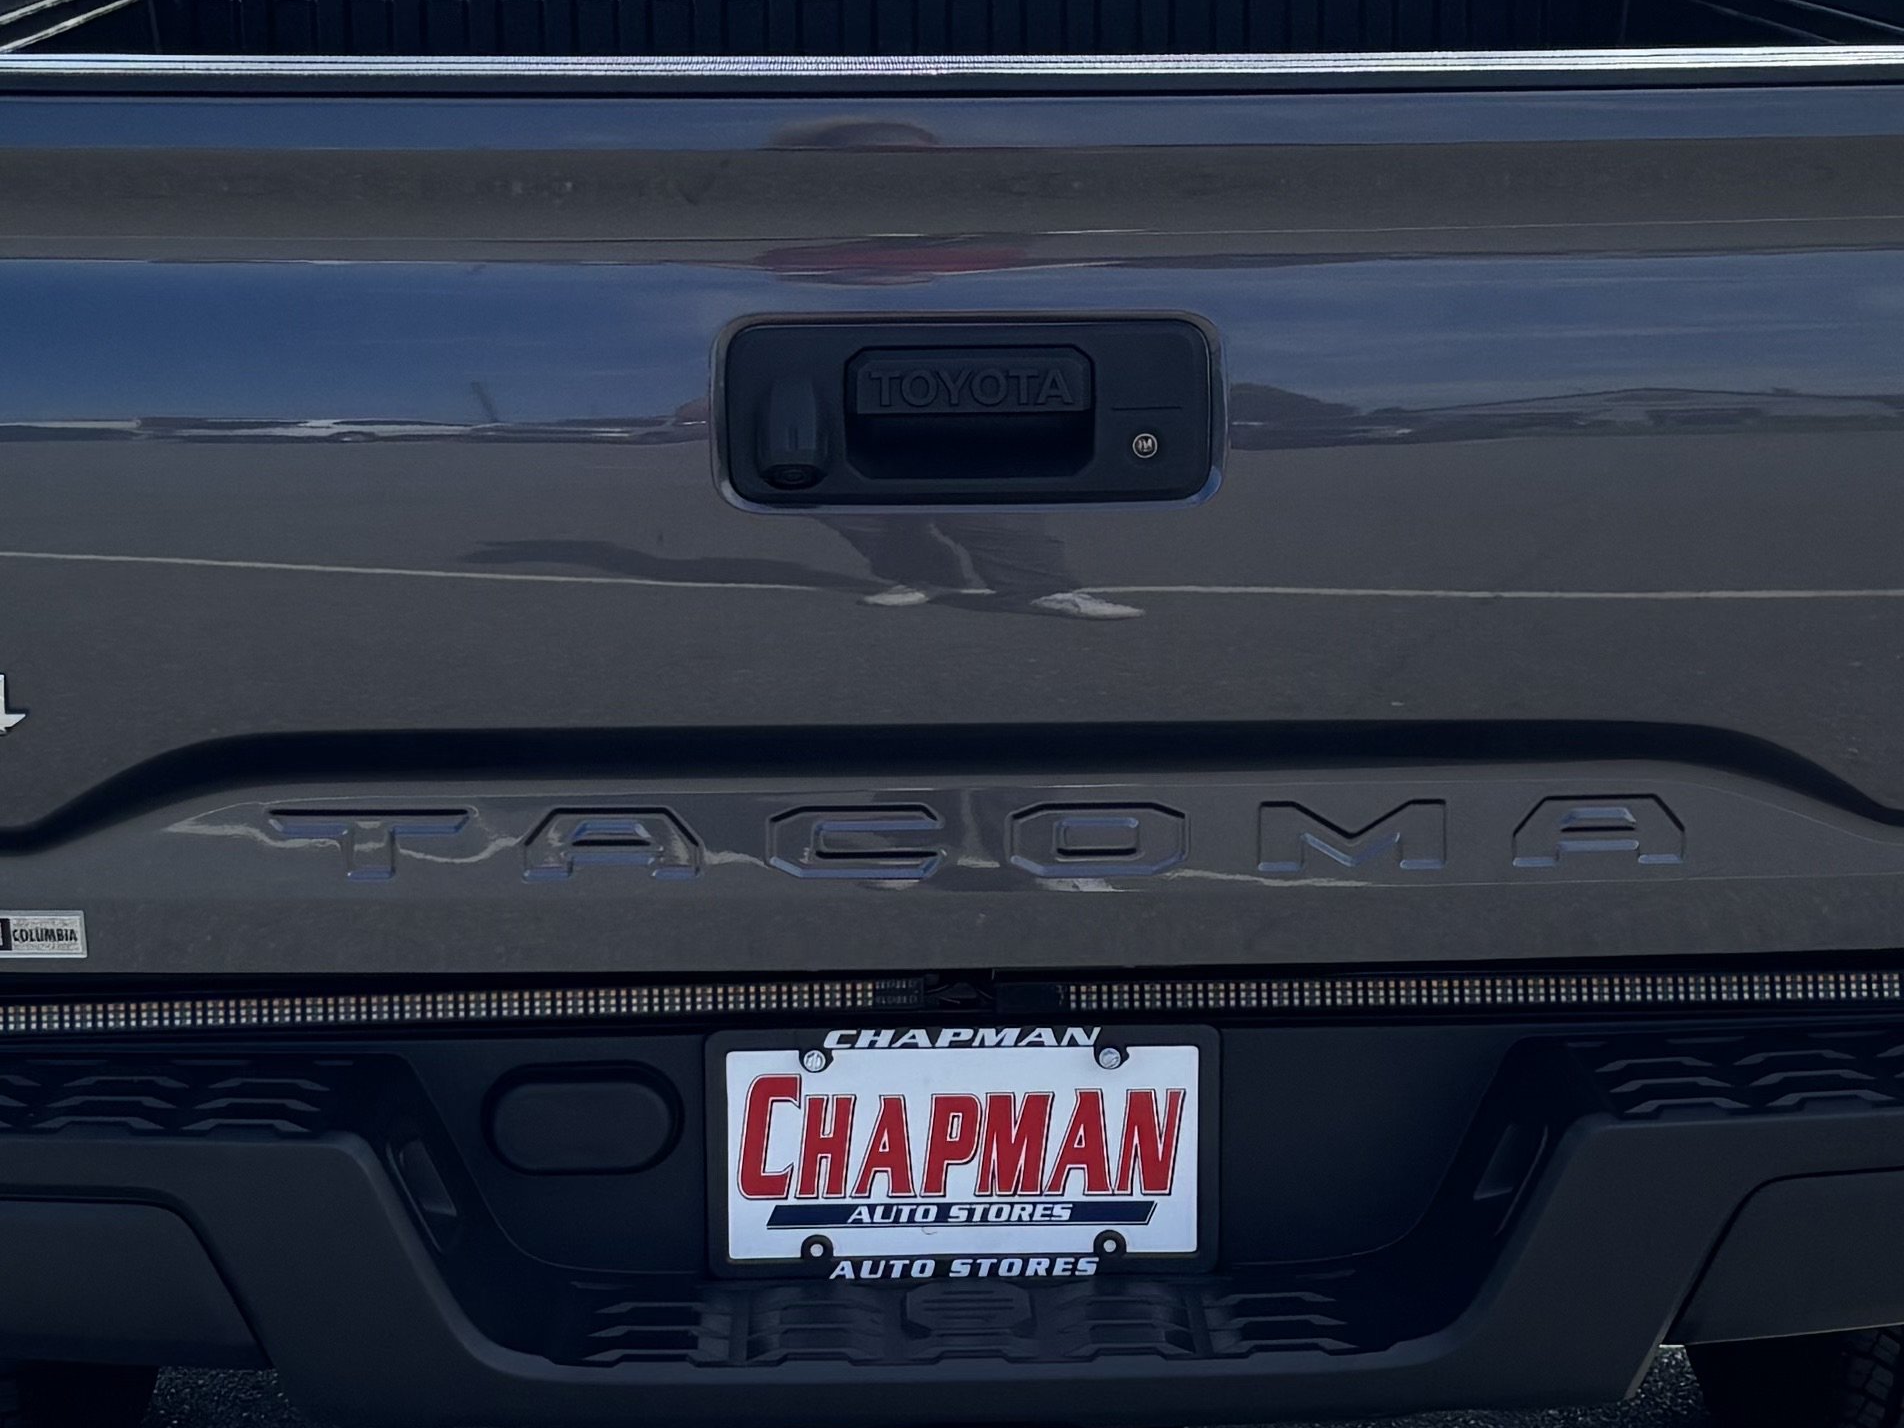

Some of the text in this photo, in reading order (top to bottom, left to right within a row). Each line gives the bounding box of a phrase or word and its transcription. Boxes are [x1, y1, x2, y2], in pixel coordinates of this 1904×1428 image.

[870, 368, 1074, 408] TOYOTA
[266, 792, 1688, 882] TACOMA
[12, 928, 79, 944] COLUMBIA
[823, 1026, 1101, 1050] CHAPMAN
[736, 1072, 1187, 1200] CHAPMAN
[847, 1202, 1073, 1225] AUTO STORES
[829, 1257, 1100, 1280] AUTO STORES
